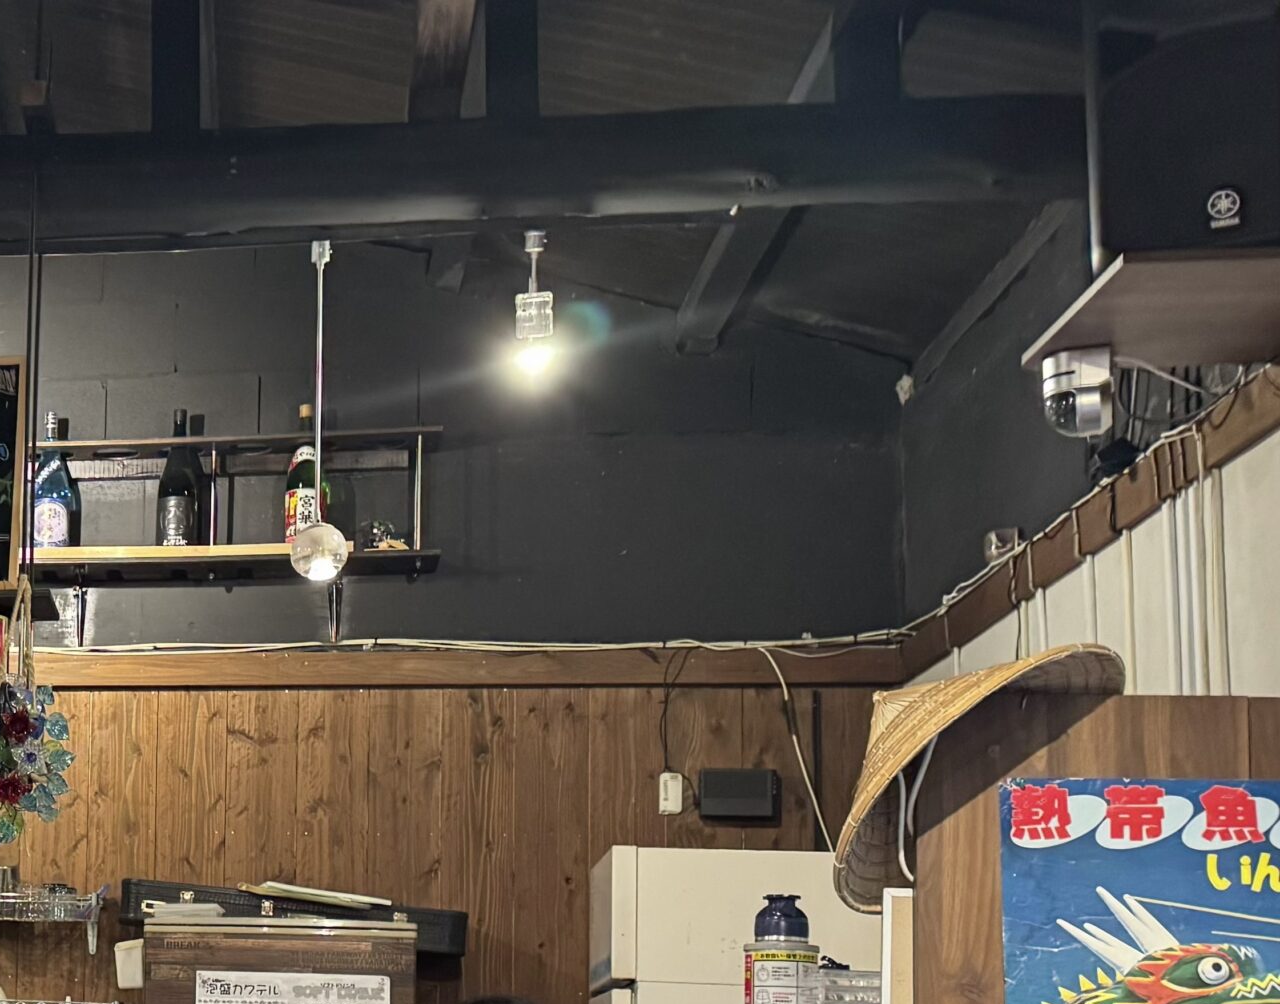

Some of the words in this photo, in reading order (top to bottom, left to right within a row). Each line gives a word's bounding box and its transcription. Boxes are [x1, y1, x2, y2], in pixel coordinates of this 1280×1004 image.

[205, 982, 280, 997] 泡盛カクテル
